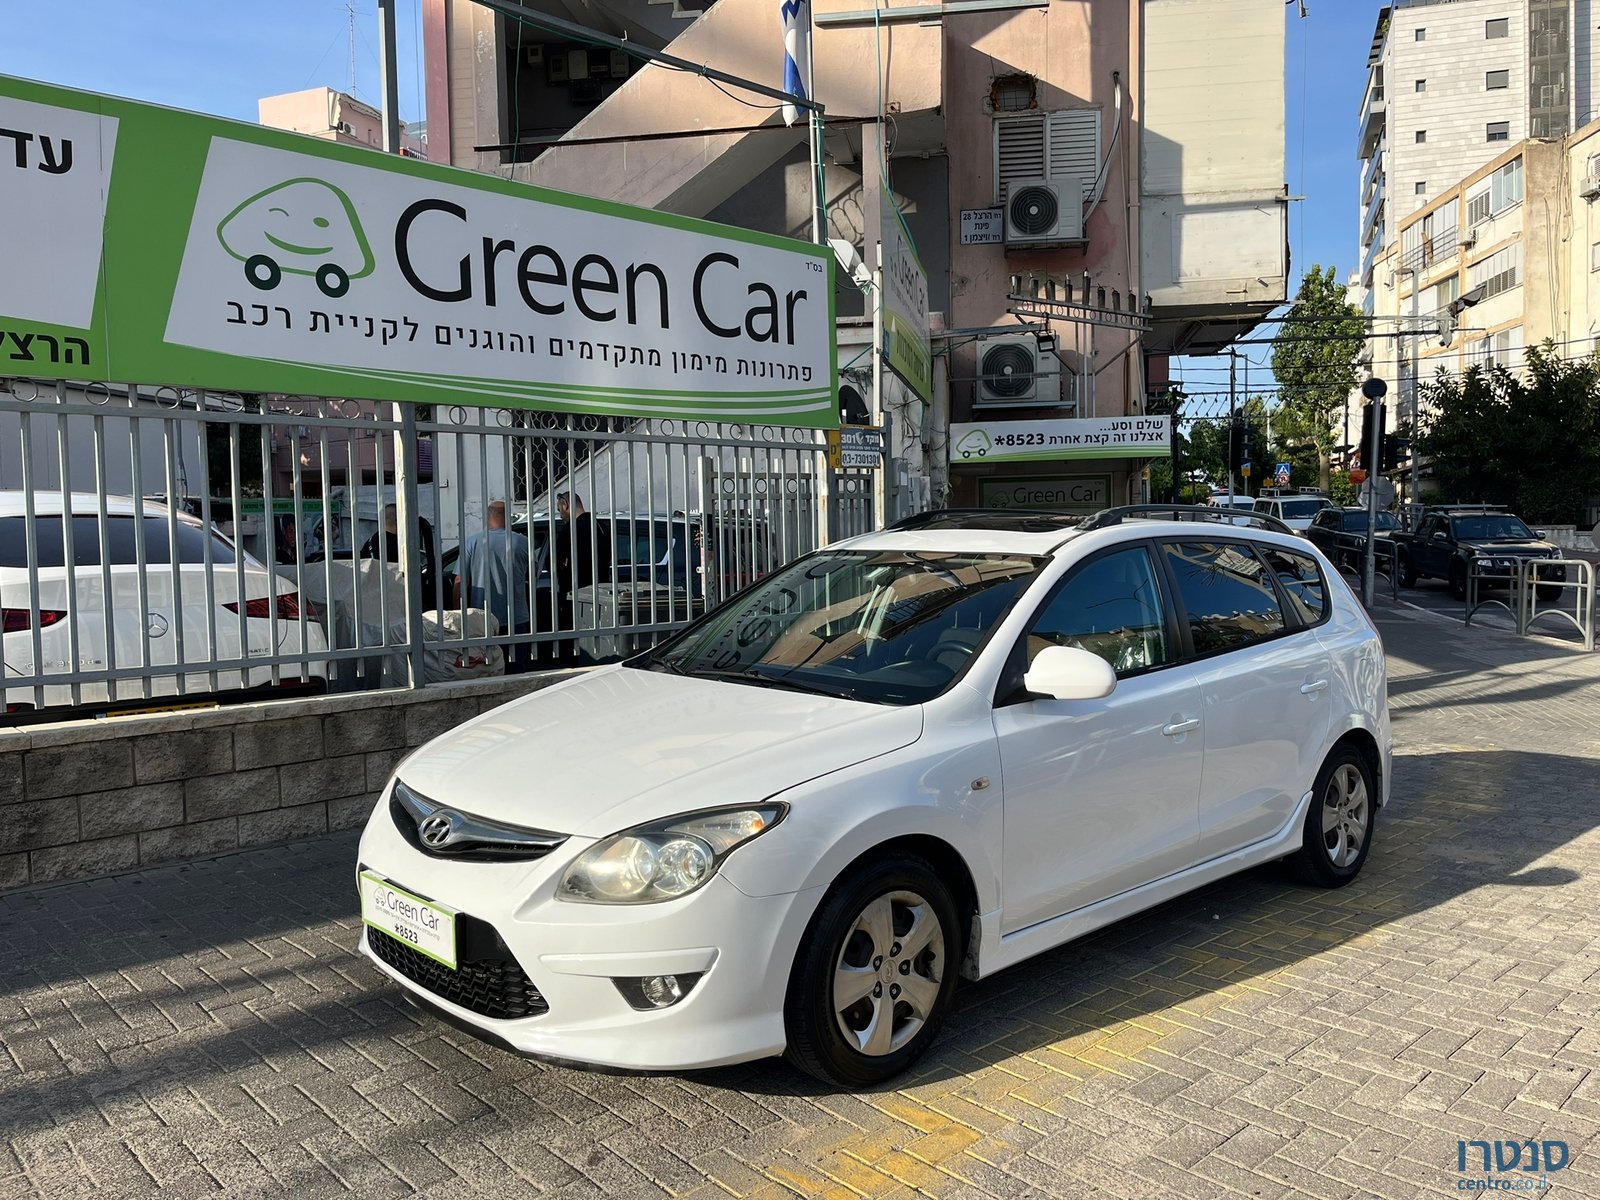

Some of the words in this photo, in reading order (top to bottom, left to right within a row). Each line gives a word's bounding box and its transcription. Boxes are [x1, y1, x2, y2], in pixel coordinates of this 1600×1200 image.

[962, 213, 972, 221] 28
[973, 211, 992, 220] הרצל
[974, 222, 990, 230] פינת
[964, 234, 968, 242] 1
[394, 198, 670, 329] Green
[692, 252, 807, 346] Car
[805, 261, 823, 273] בס"ד
[226, 301, 292, 329] רכב
[309, 310, 419, 346] לקניית
[434, 325, 535, 354] והוגנים
[549, 337, 662, 368] מתקדמים
[671, 351, 728, 374] מימון
[736, 358, 813, 382] פתרונות
[1136, 418, 1164, 430] שלם
[841, 434, 856, 444] 301
[1049, 435, 1080, 445] אחרת
[1084, 434, 1109, 445] קצת
[1113, 432, 1126, 442] זה
[1130, 430, 1164, 442] אצלנו
[1013, 486, 1066, 504] Green
[1070, 485, 1101, 503] Car
[387, 891, 418, 922] Green
[420, 907, 440, 931] Car
